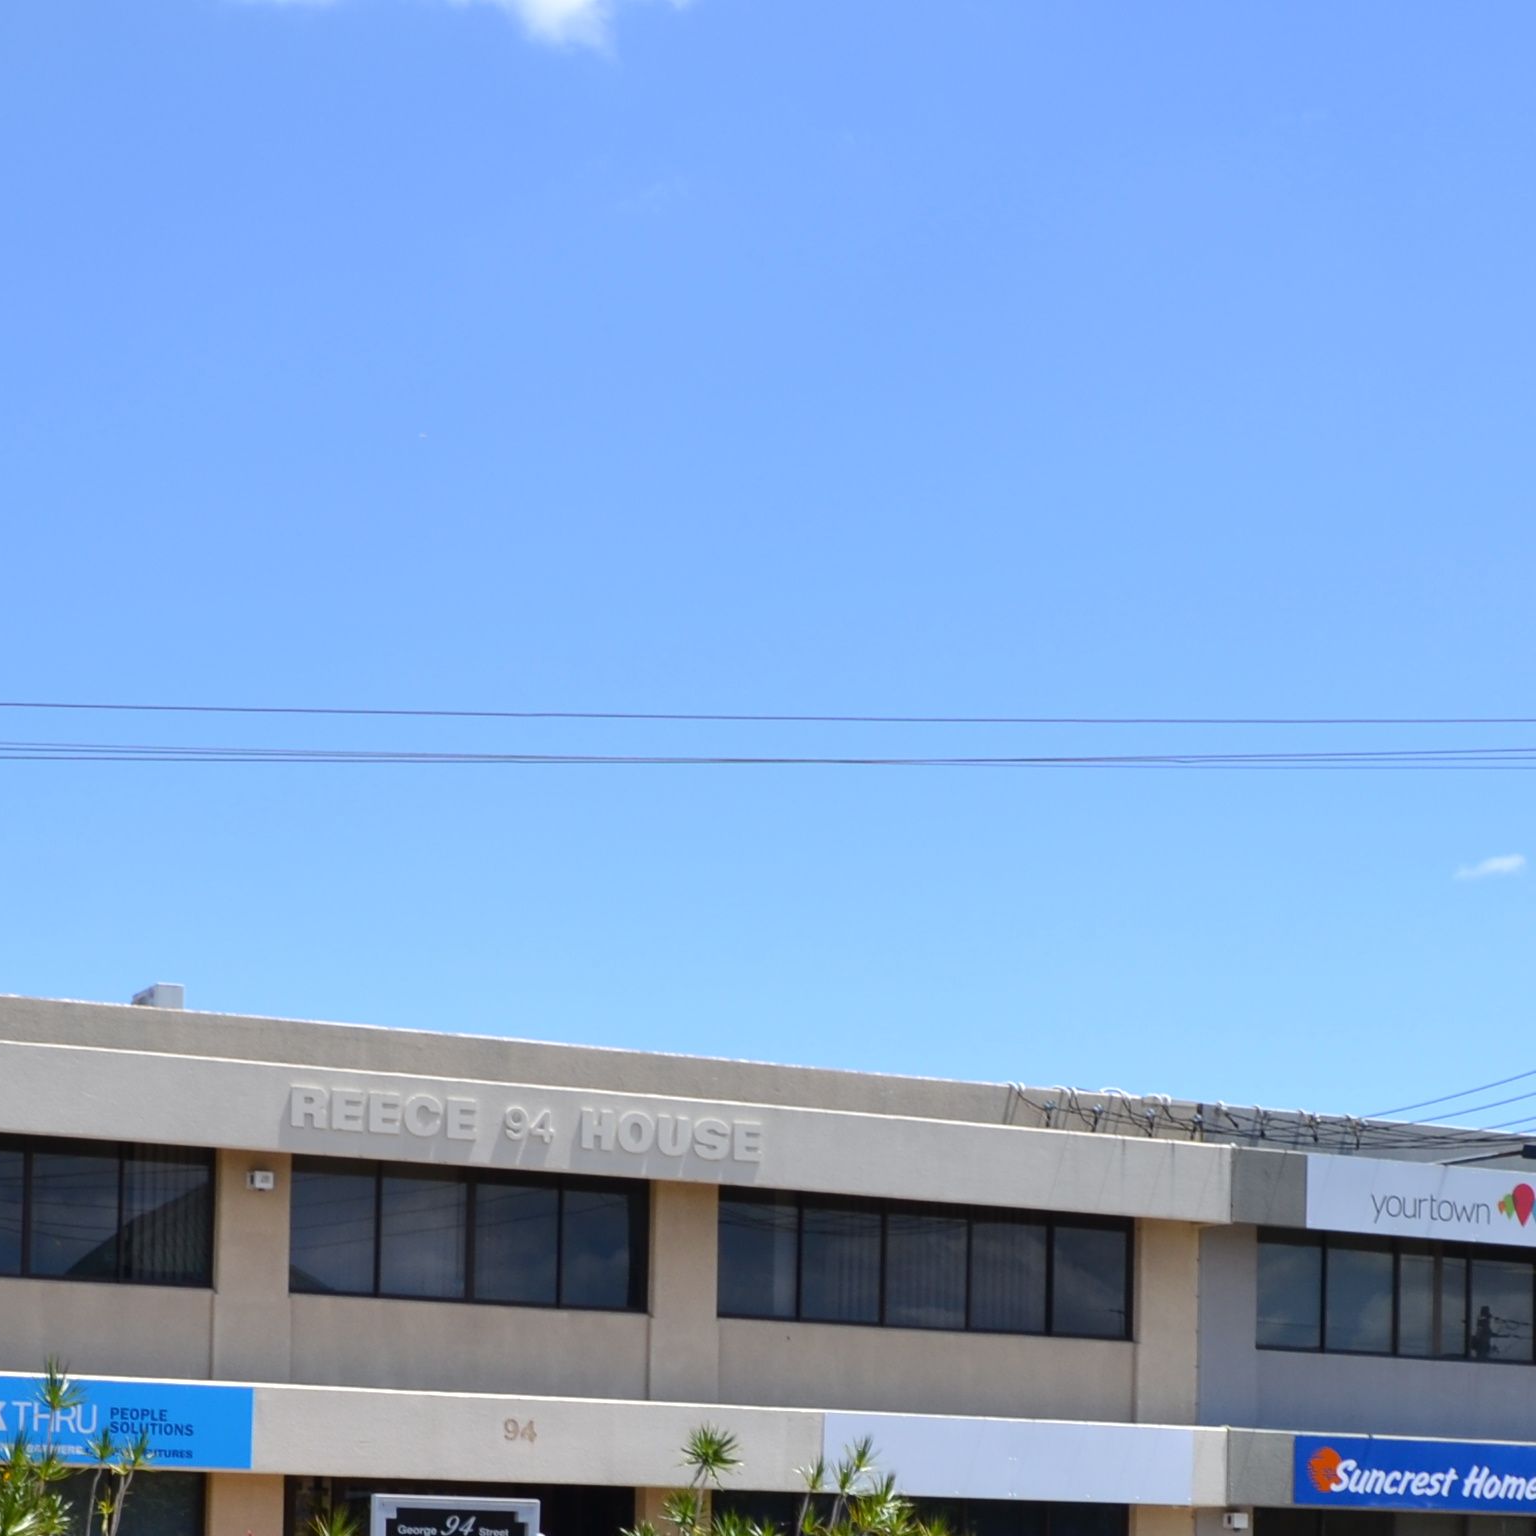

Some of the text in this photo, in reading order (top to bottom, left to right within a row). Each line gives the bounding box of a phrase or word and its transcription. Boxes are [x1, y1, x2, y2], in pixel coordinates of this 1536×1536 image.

[290, 1084, 762, 1163] REECE 94 HOUSE
[1370, 1193, 1490, 1225] yourtown
[110, 1407, 168, 1423] PEOPLE
[109, 1420, 194, 1437] SOLUTIONS
[504, 1418, 537, 1442] 94
[1331, 1459, 1458, 1498] Suncrest
[397, 1525, 437, 1536] George
[440, 1515, 477, 1536] 94
